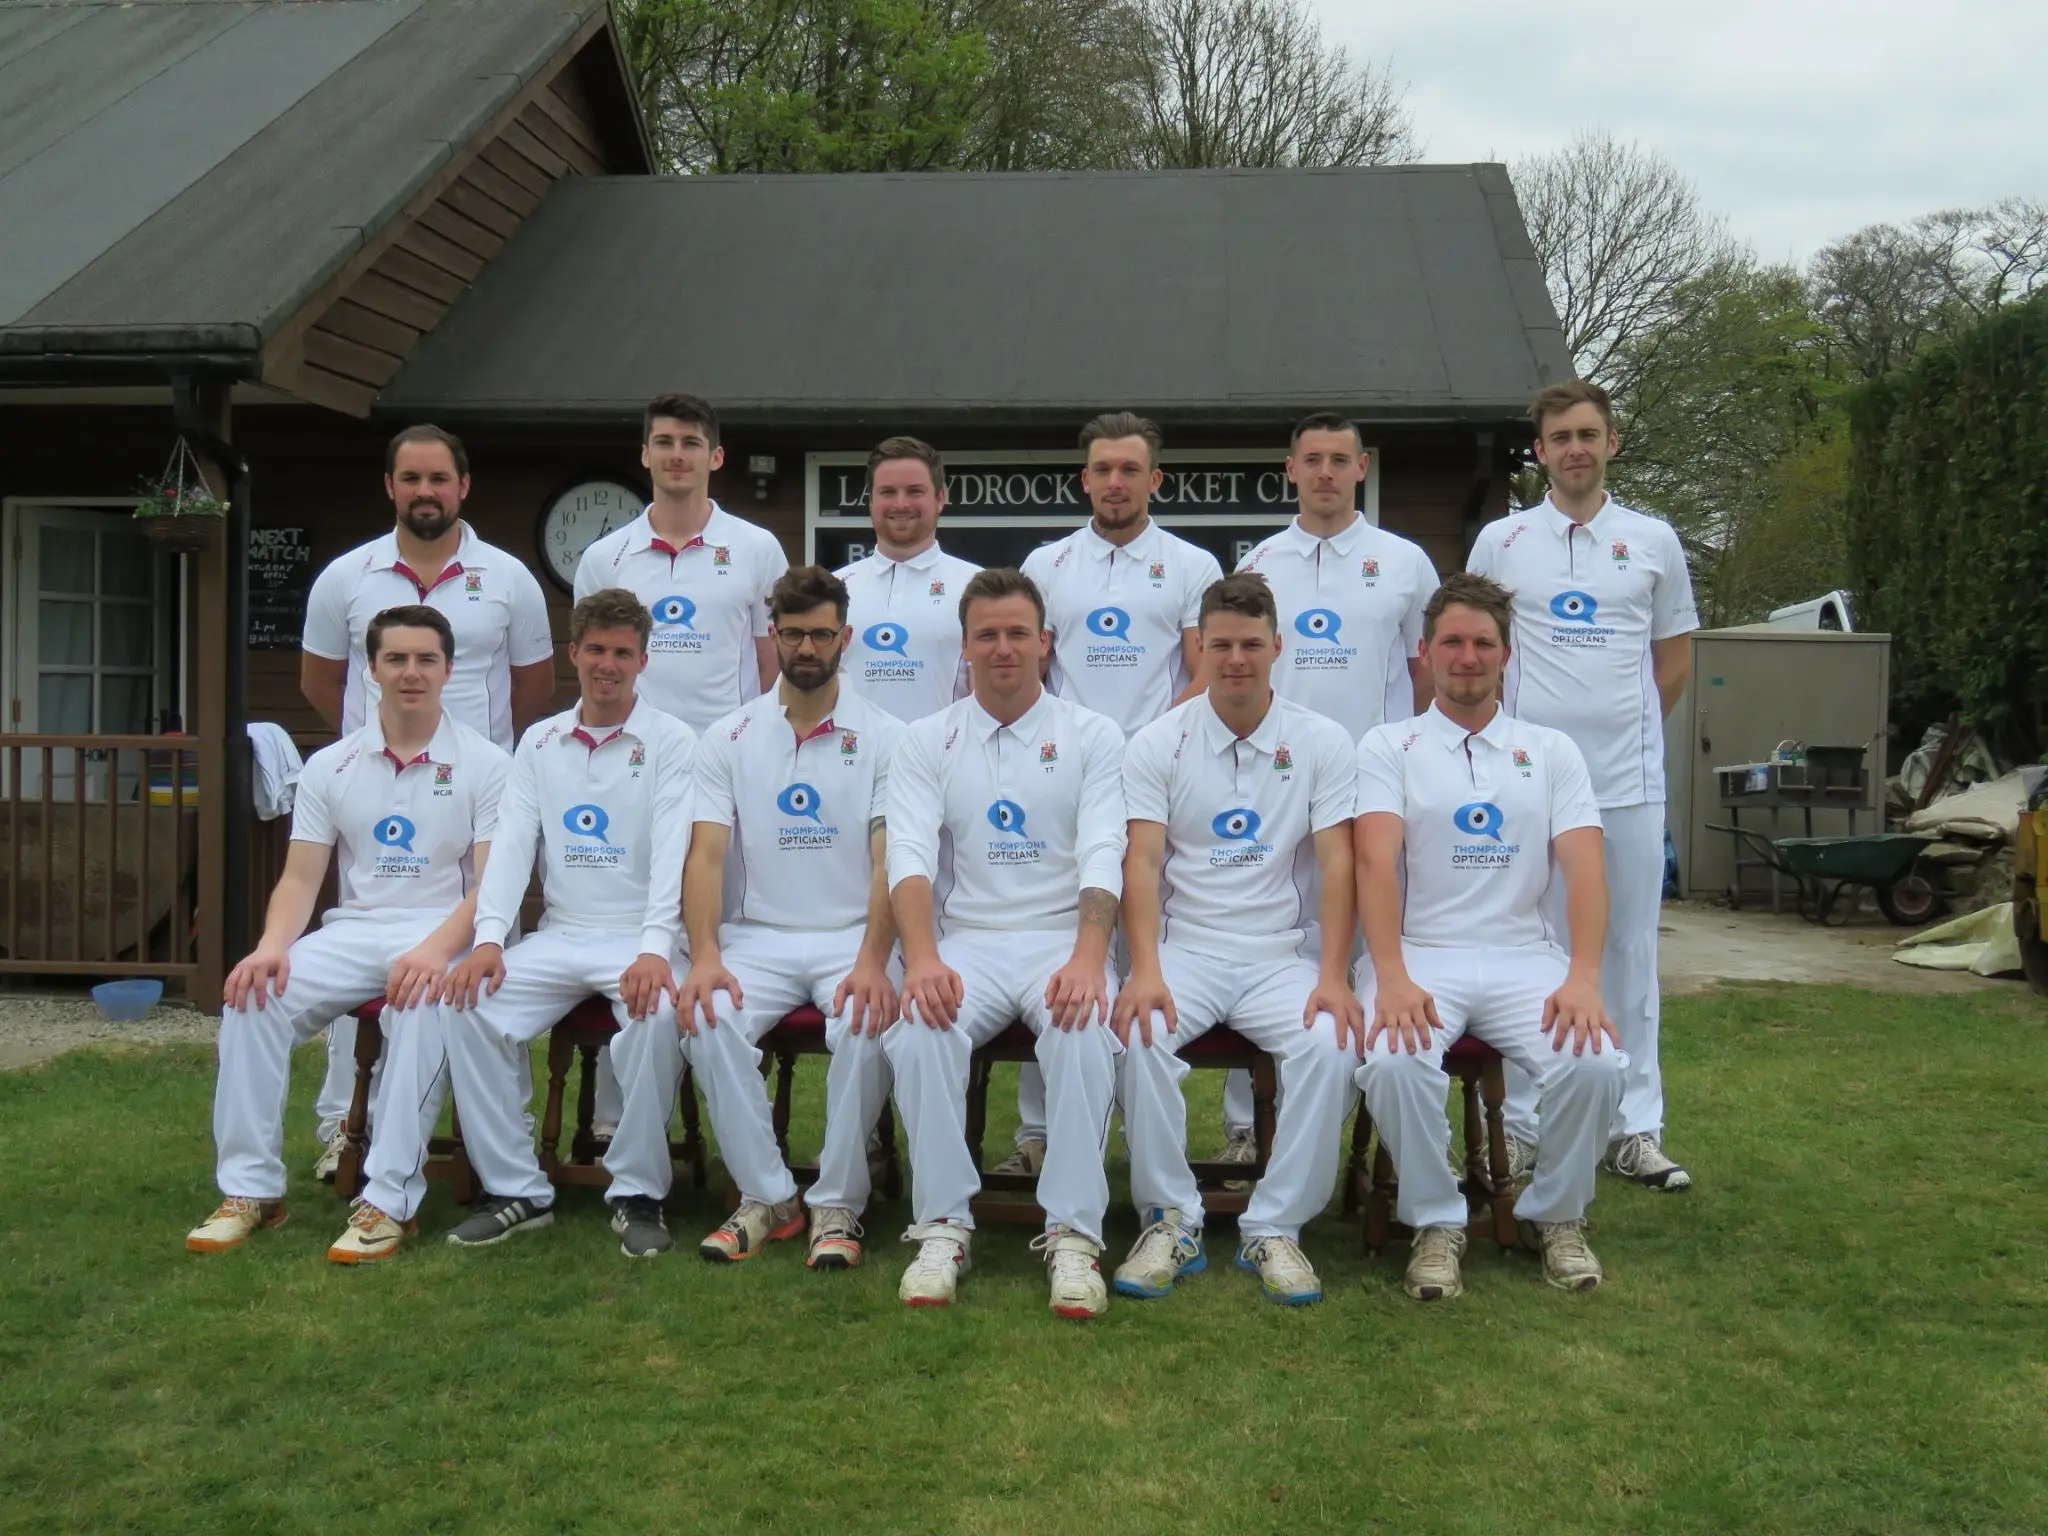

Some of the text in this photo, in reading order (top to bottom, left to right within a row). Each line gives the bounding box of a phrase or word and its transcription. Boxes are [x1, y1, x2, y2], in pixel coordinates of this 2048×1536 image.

[838, 471, 1299, 506] LYDROCK CKET CL
[593, 489, 609, 506] 12
[576, 496, 588, 512] 11
[562, 511, 577, 527] 10
[250, 527, 304, 546] NEXT
[555, 529, 567, 546] 9
[561, 549, 574, 566] 8
[651, 632, 711, 641] THOMPSONS
[1552, 627, 1617, 636] THOMPSONS
[651, 640, 703, 649] OPTICIANS
[1550, 635, 1607, 644] OPTICIANS
[1086, 645, 1147, 654] THOMPSONS
[1295, 647, 1358, 656] THOMPSONS
[1086, 654, 1139, 663] OPTICIANS
[1294, 656, 1348, 665] OPTICIANS
[864, 660, 925, 669] THOMPSONS
[864, 669, 916, 678] OPTICIANS
[777, 826, 839, 836] THOMPSONS
[778, 836, 832, 846] OPTICIANS
[988, 840, 1047, 851] THOMPSONS
[564, 845, 626, 855] THOMPSONS
[1453, 845, 1520, 855] THOMPSONS
[564, 854, 619, 864] OPTICIANS
[987, 850, 1040, 861] OPTICIANS
[1452, 854, 1511, 864] OPTICIANS
